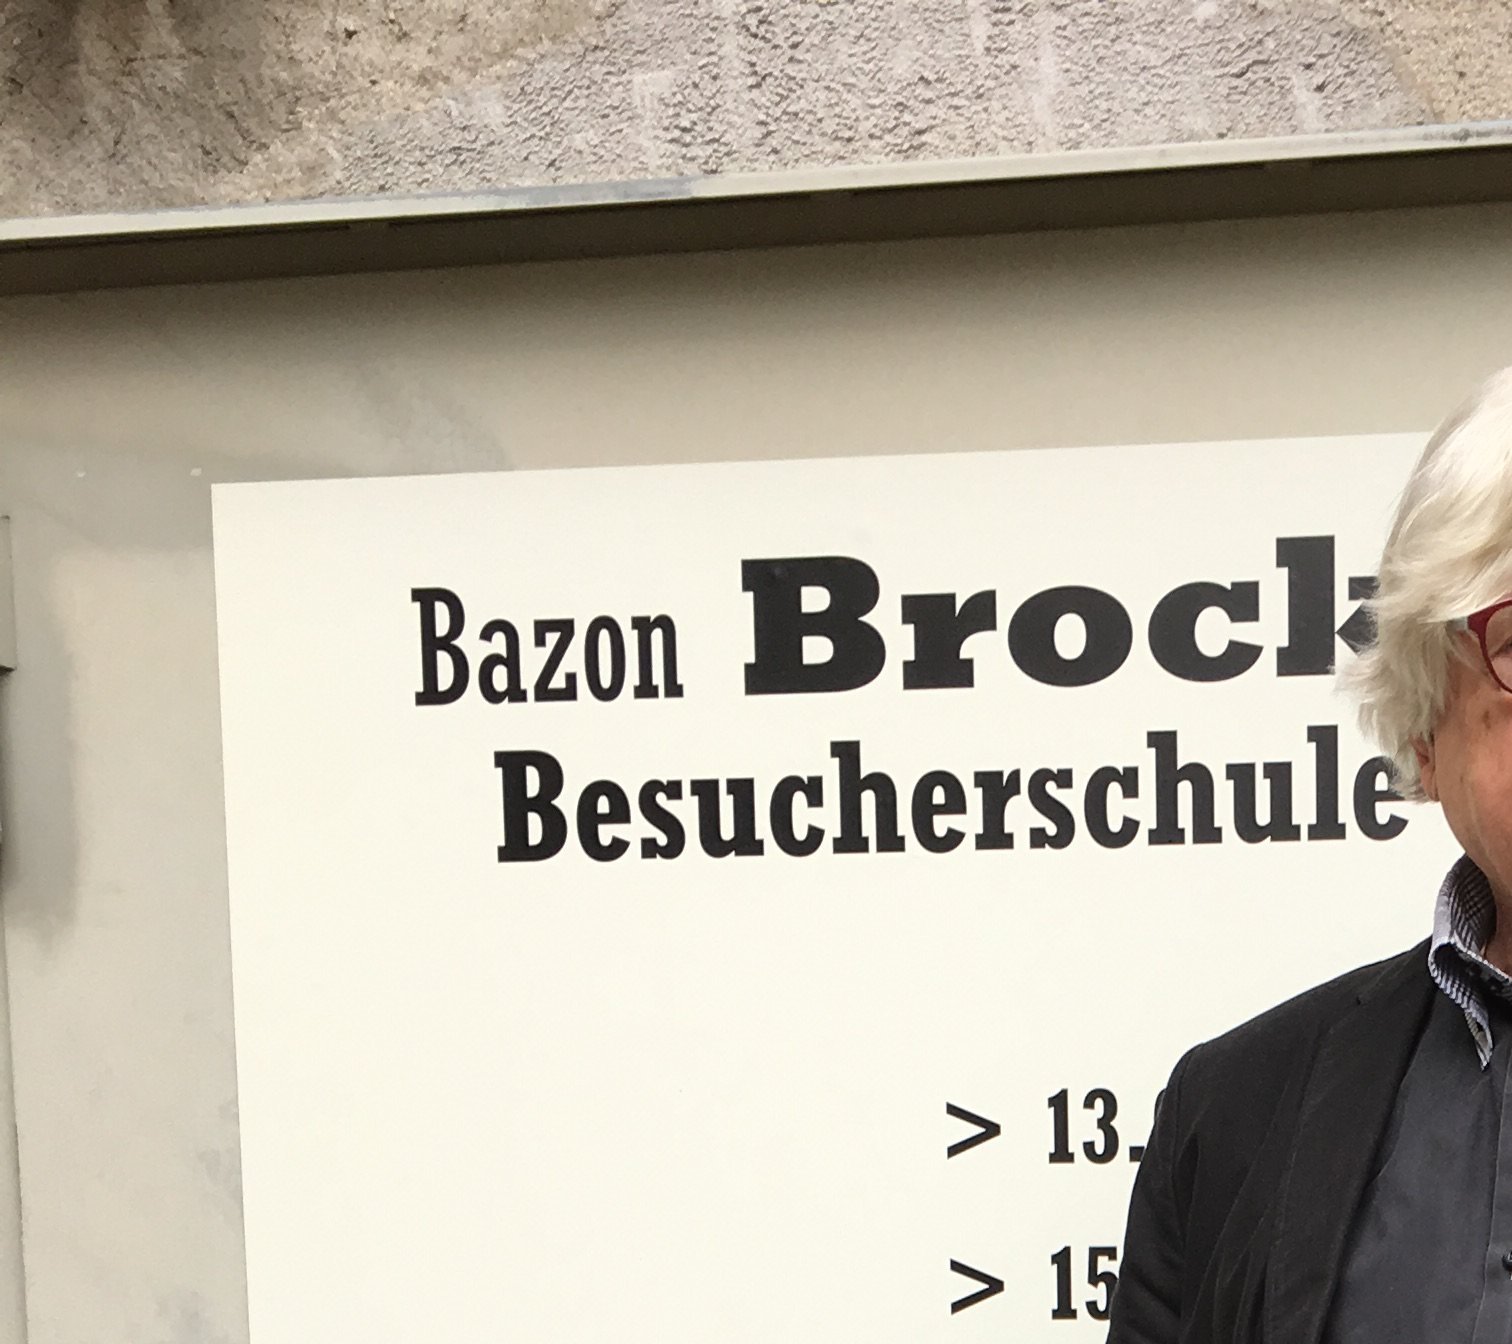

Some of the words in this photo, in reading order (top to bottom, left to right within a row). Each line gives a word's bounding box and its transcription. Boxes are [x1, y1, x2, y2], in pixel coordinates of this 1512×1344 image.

[411, 586, 684, 706] Bazon
[740, 535, 1380, 696] Brock
[488, 723, 1410, 862] Besucherschule
[1051, 1246, 1119, 1321] 15
